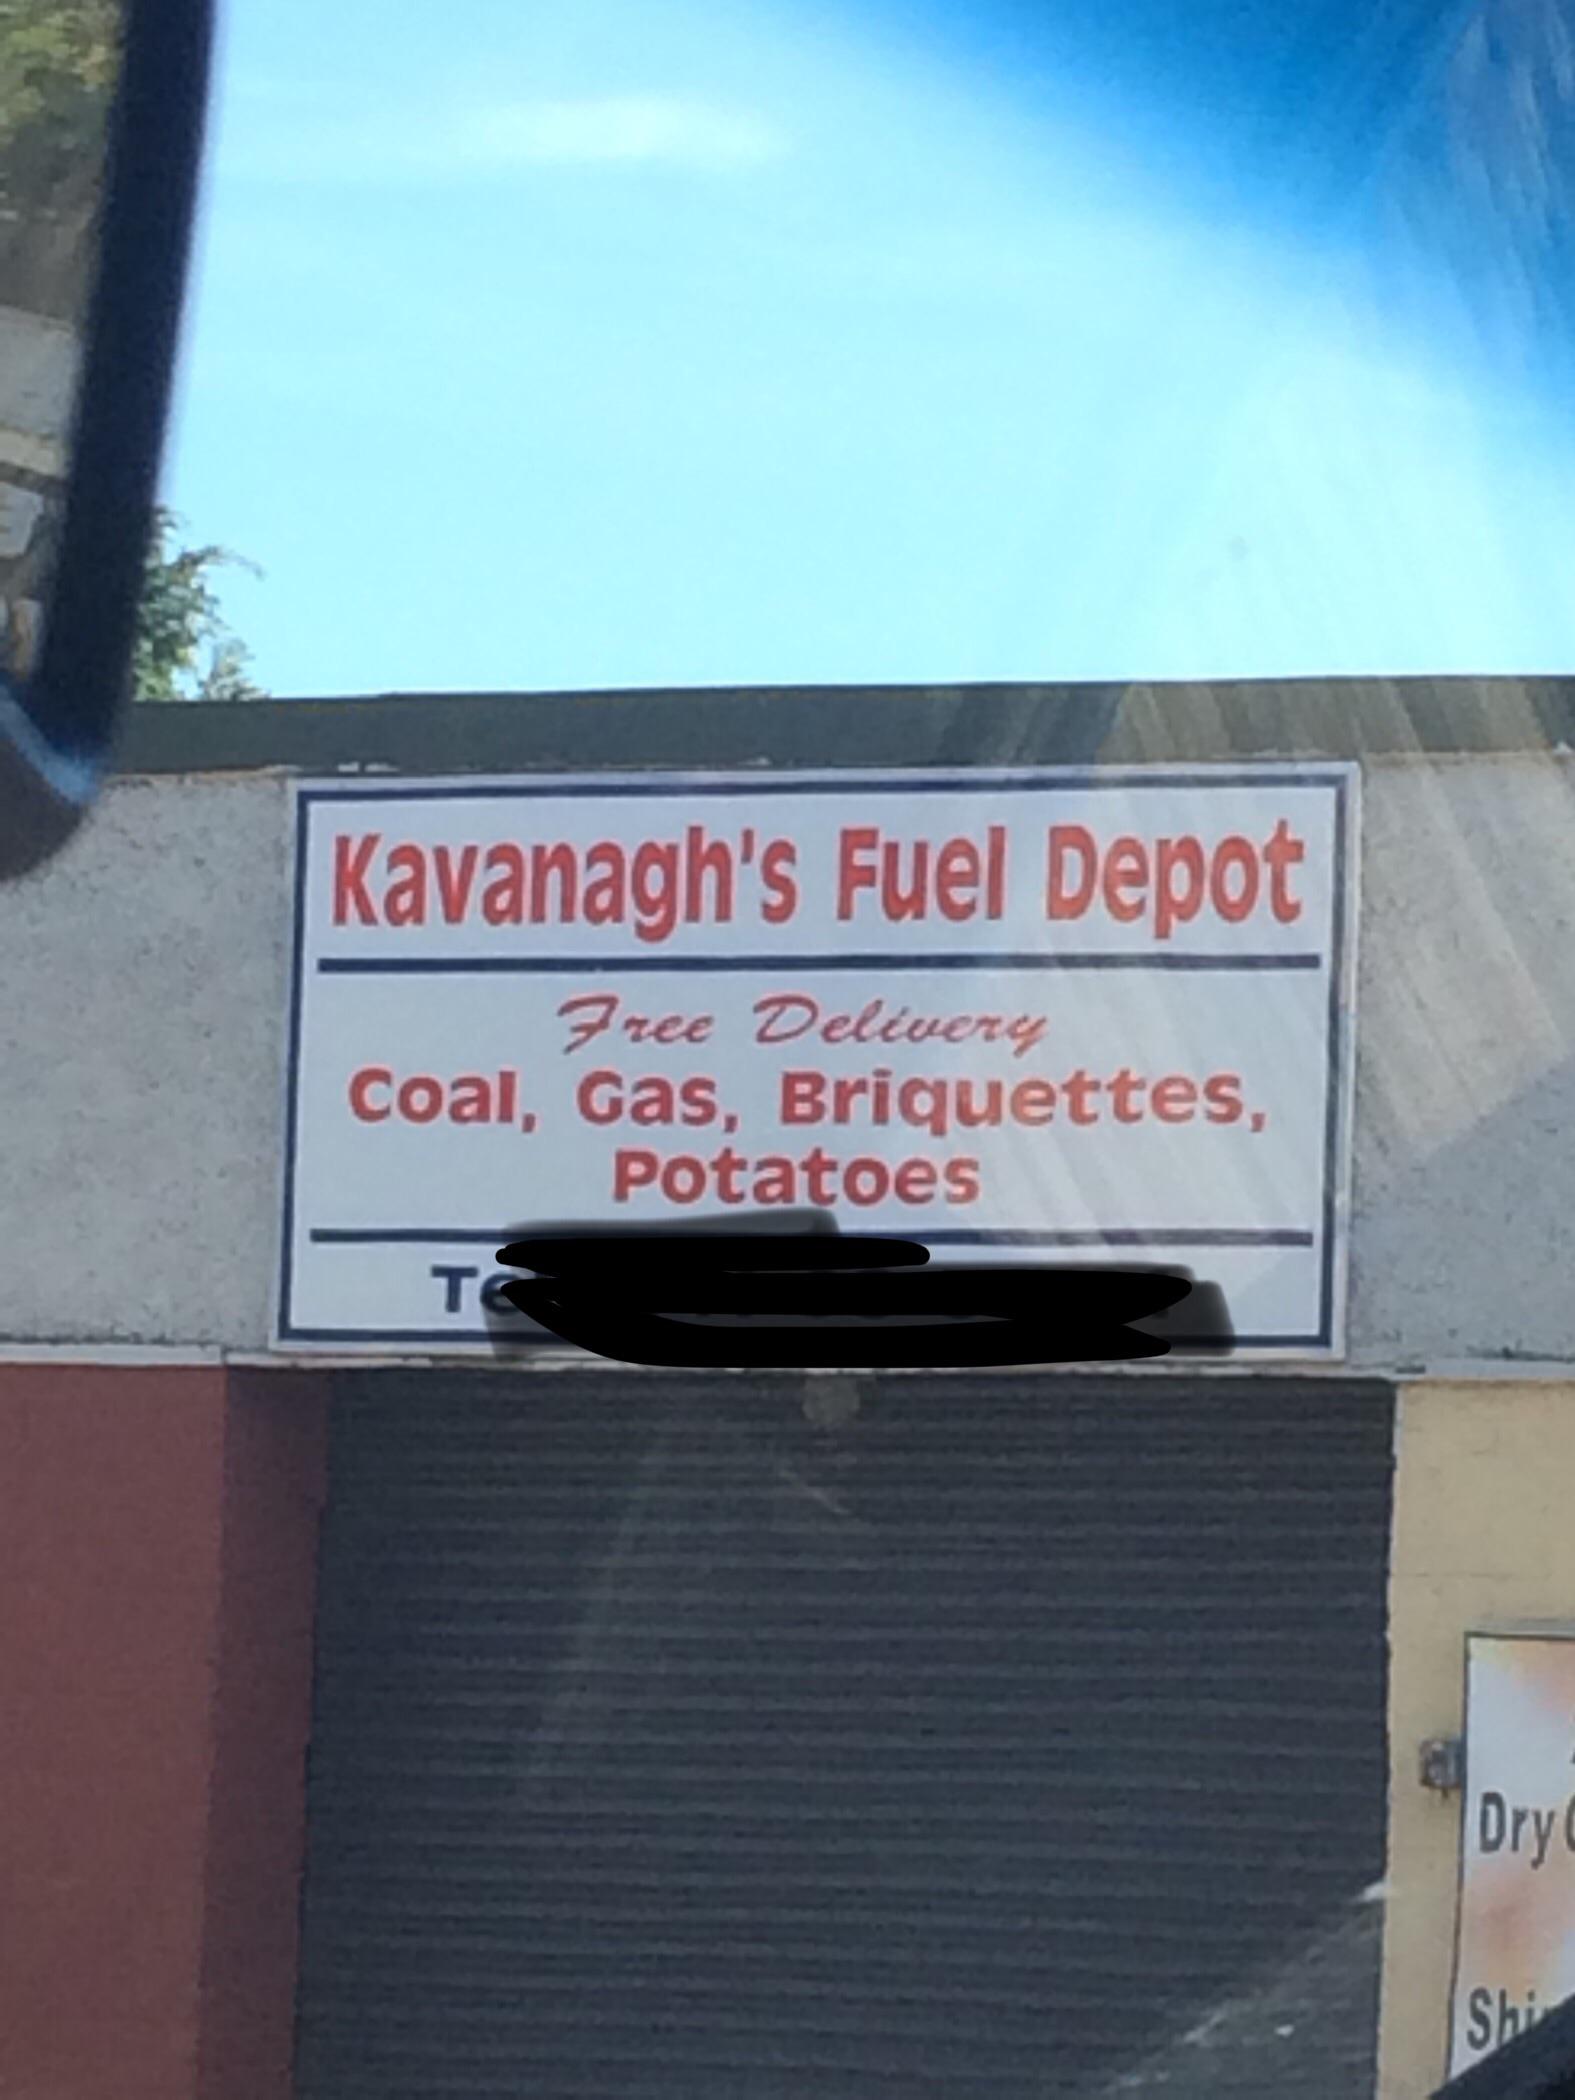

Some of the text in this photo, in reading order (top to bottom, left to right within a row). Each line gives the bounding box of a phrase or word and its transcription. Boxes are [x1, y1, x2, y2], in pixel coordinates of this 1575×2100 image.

[332, 819, 1304, 942] Kavanagh's Fuel Depot
[557, 995, 1046, 1056] Free Delivery
[349, 1068, 1266, 1136] Coal, Gas, Briquettes,
[613, 1148, 980, 1206] Potatoes
[1479, 1792, 1554, 1869] Dry
